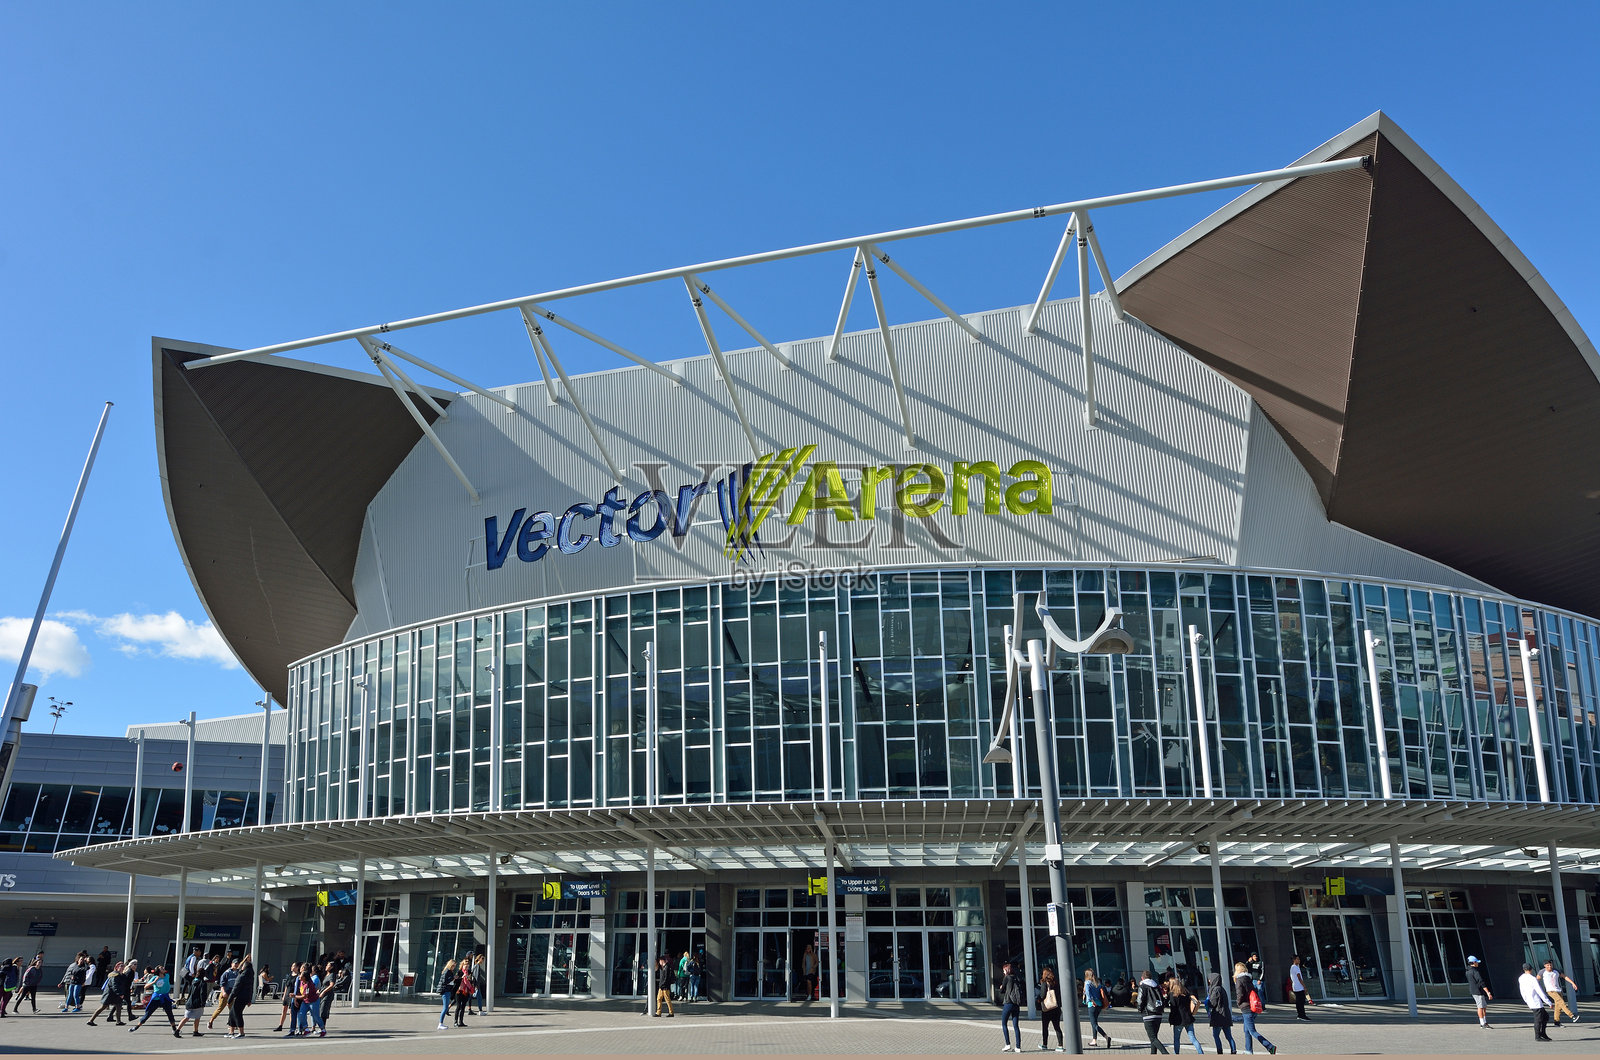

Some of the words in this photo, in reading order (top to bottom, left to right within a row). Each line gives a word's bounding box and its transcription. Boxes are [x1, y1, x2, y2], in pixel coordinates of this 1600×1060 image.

[786, 460, 1053, 526] Arena
[545, 882, 554, 899] D
[1329, 877, 1338, 895] F
[317, 891, 324, 906] C
